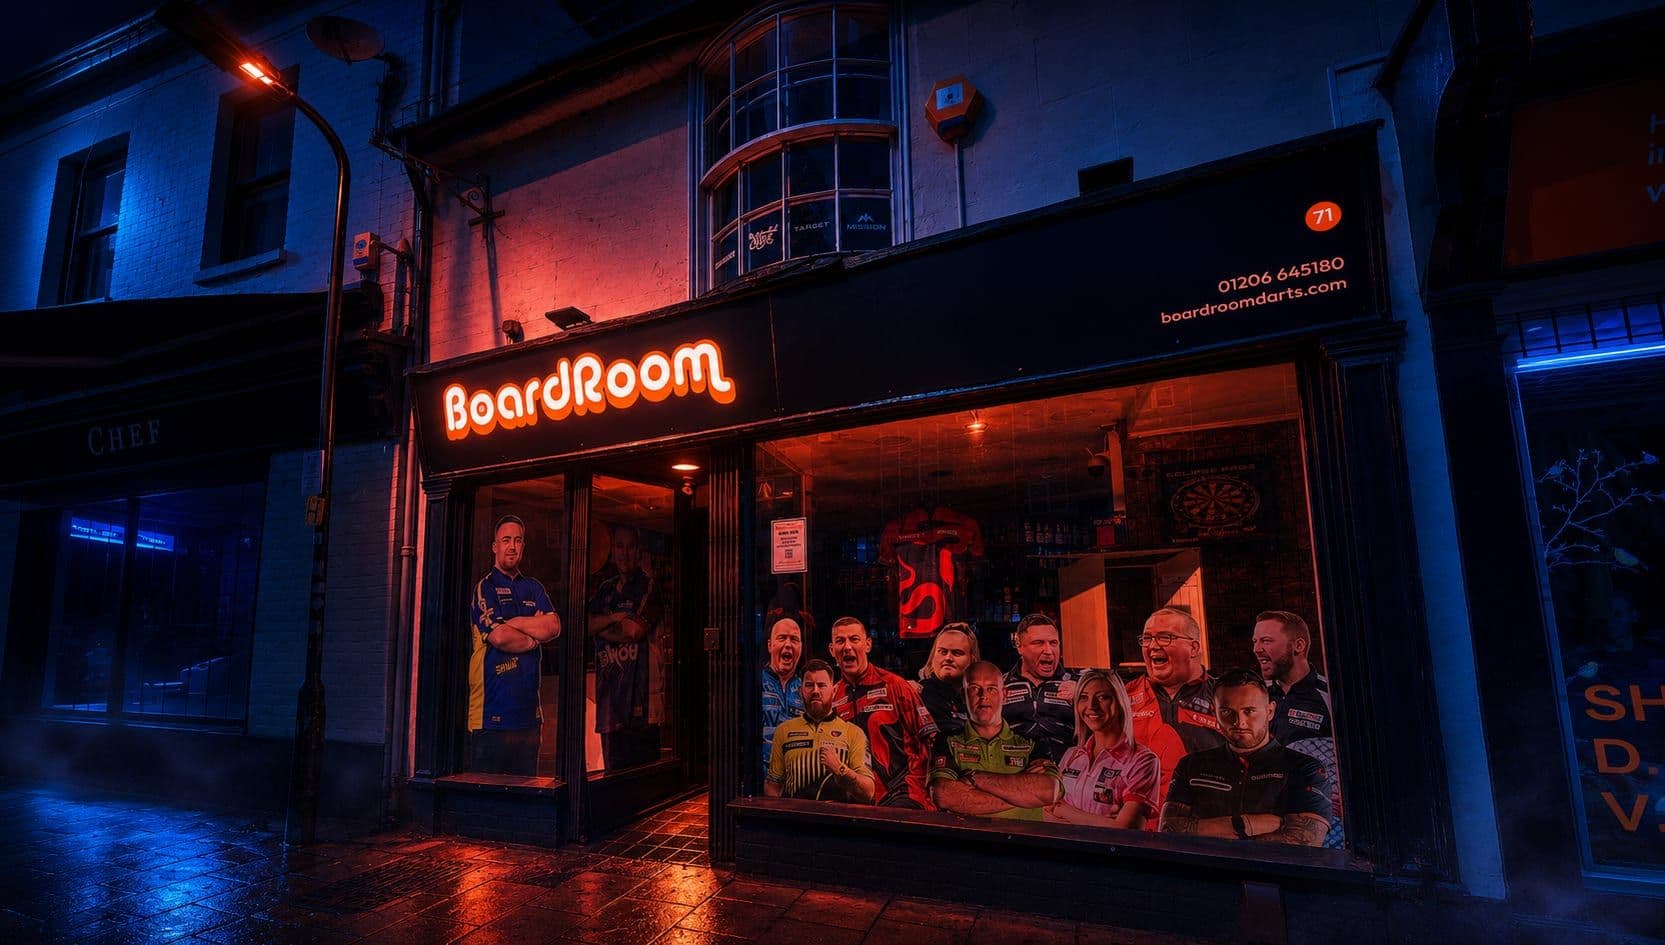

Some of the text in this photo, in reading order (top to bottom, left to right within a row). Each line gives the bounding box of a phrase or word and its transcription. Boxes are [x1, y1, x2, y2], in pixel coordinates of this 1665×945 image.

[793, 221, 831, 232] TARGET
[846, 223, 887, 231] MISSION
[1312, 207, 1334, 225] 71
[1218, 257, 1345, 294] 01206 645180
[1161, 279, 1347, 324] boardroomdarts.com
[443, 339, 736, 441] BoardRoom
[1593, 737, 1660, 775] D.
